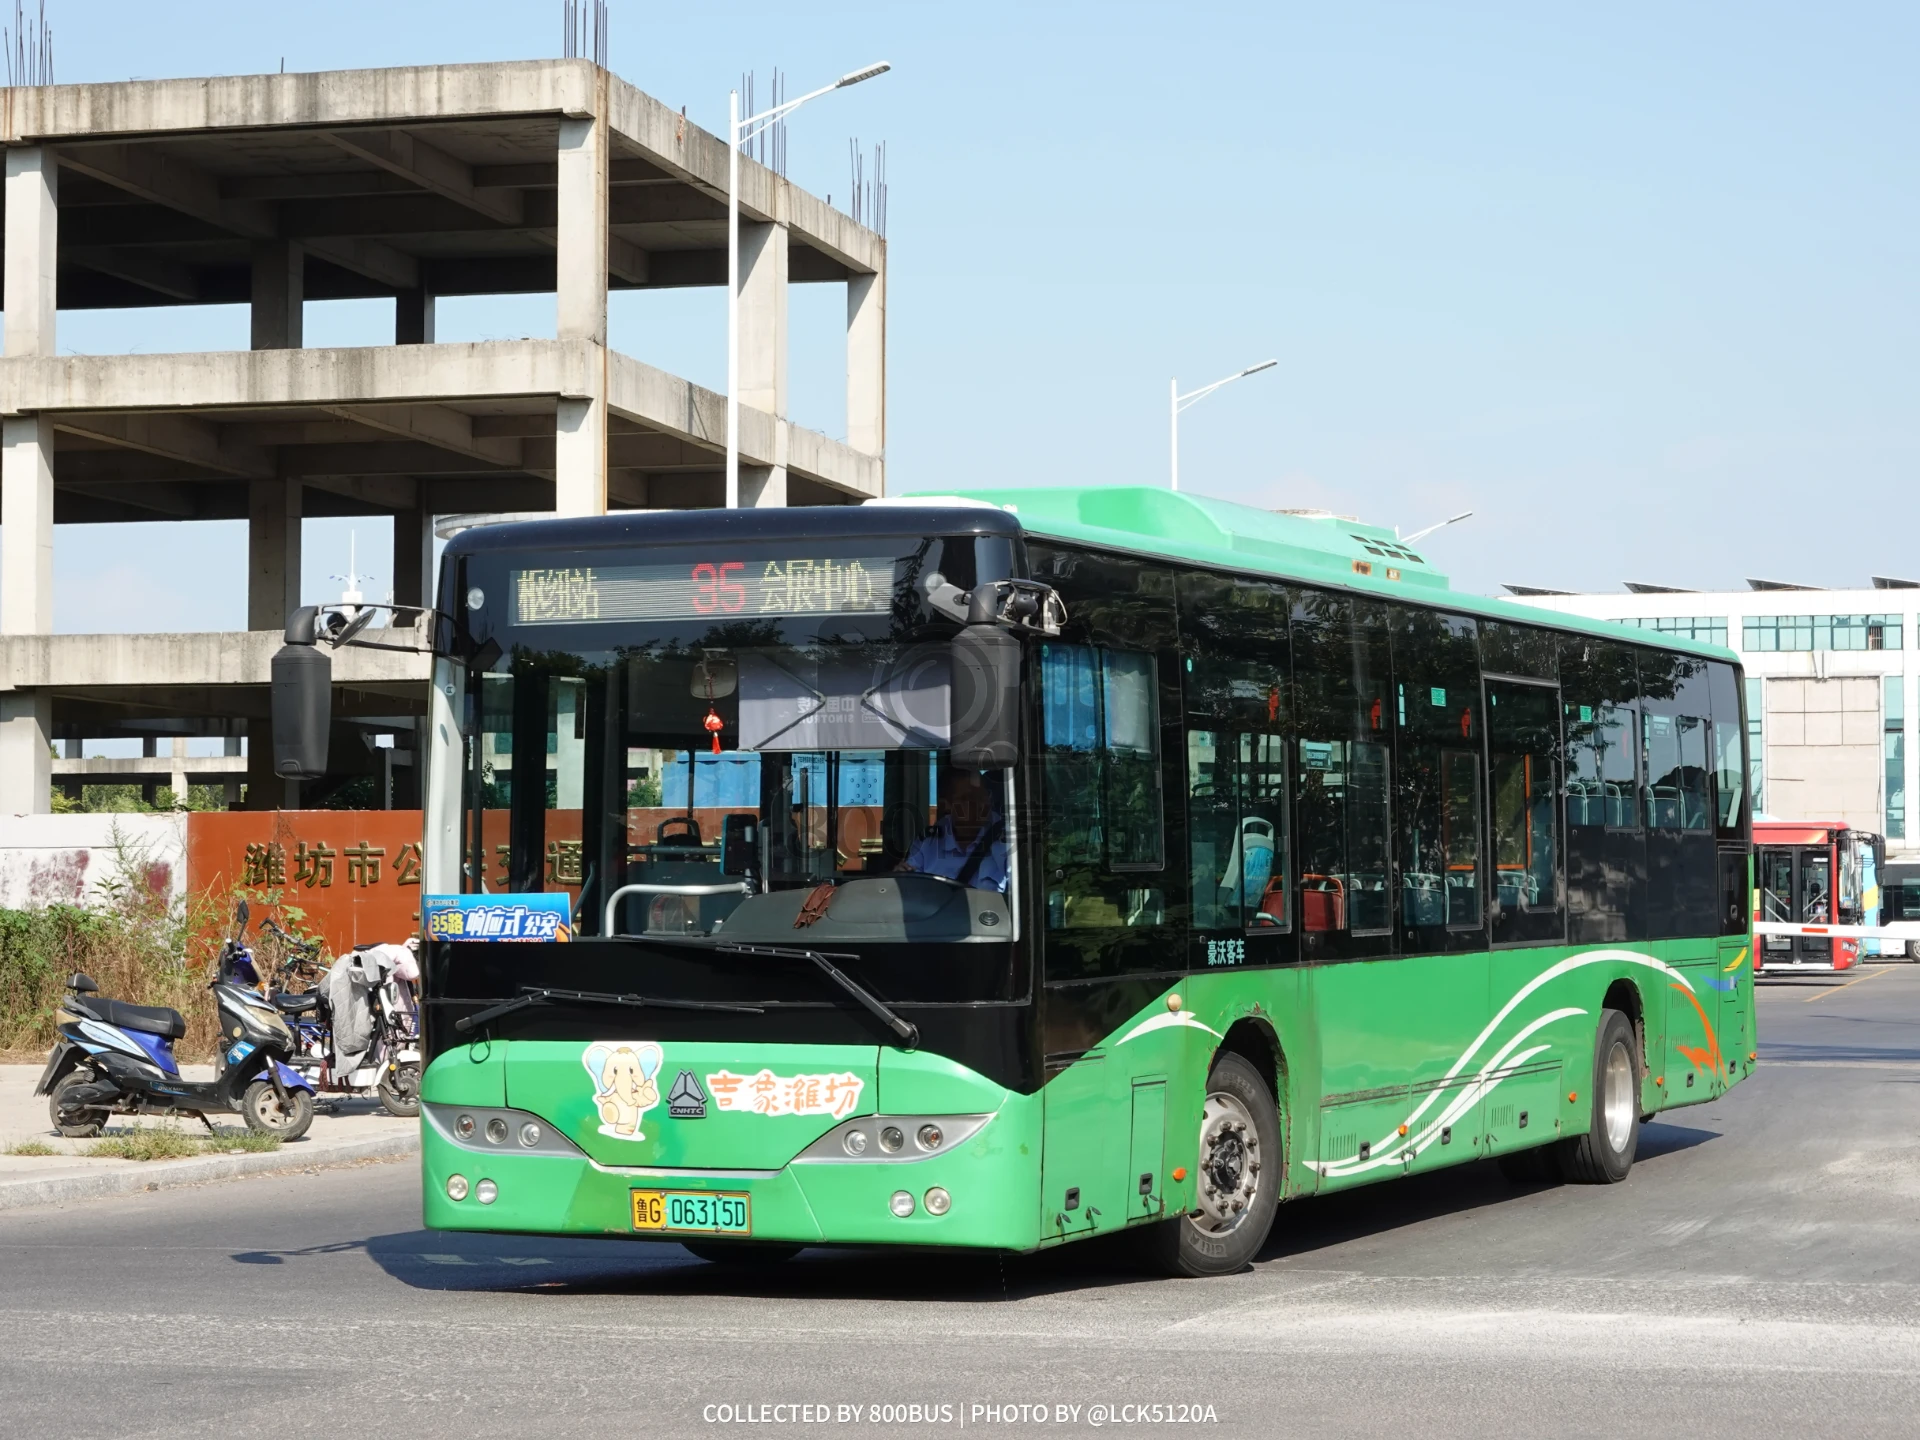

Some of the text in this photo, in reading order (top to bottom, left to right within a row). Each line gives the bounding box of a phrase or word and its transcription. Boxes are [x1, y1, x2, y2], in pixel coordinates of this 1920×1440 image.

[691, 562, 745, 613] 35
[759, 559, 872, 613] 会展中心
[1207, 939, 1245, 965] 豪沃客车
[710, 1074, 860, 1115] 吉象潍坊
